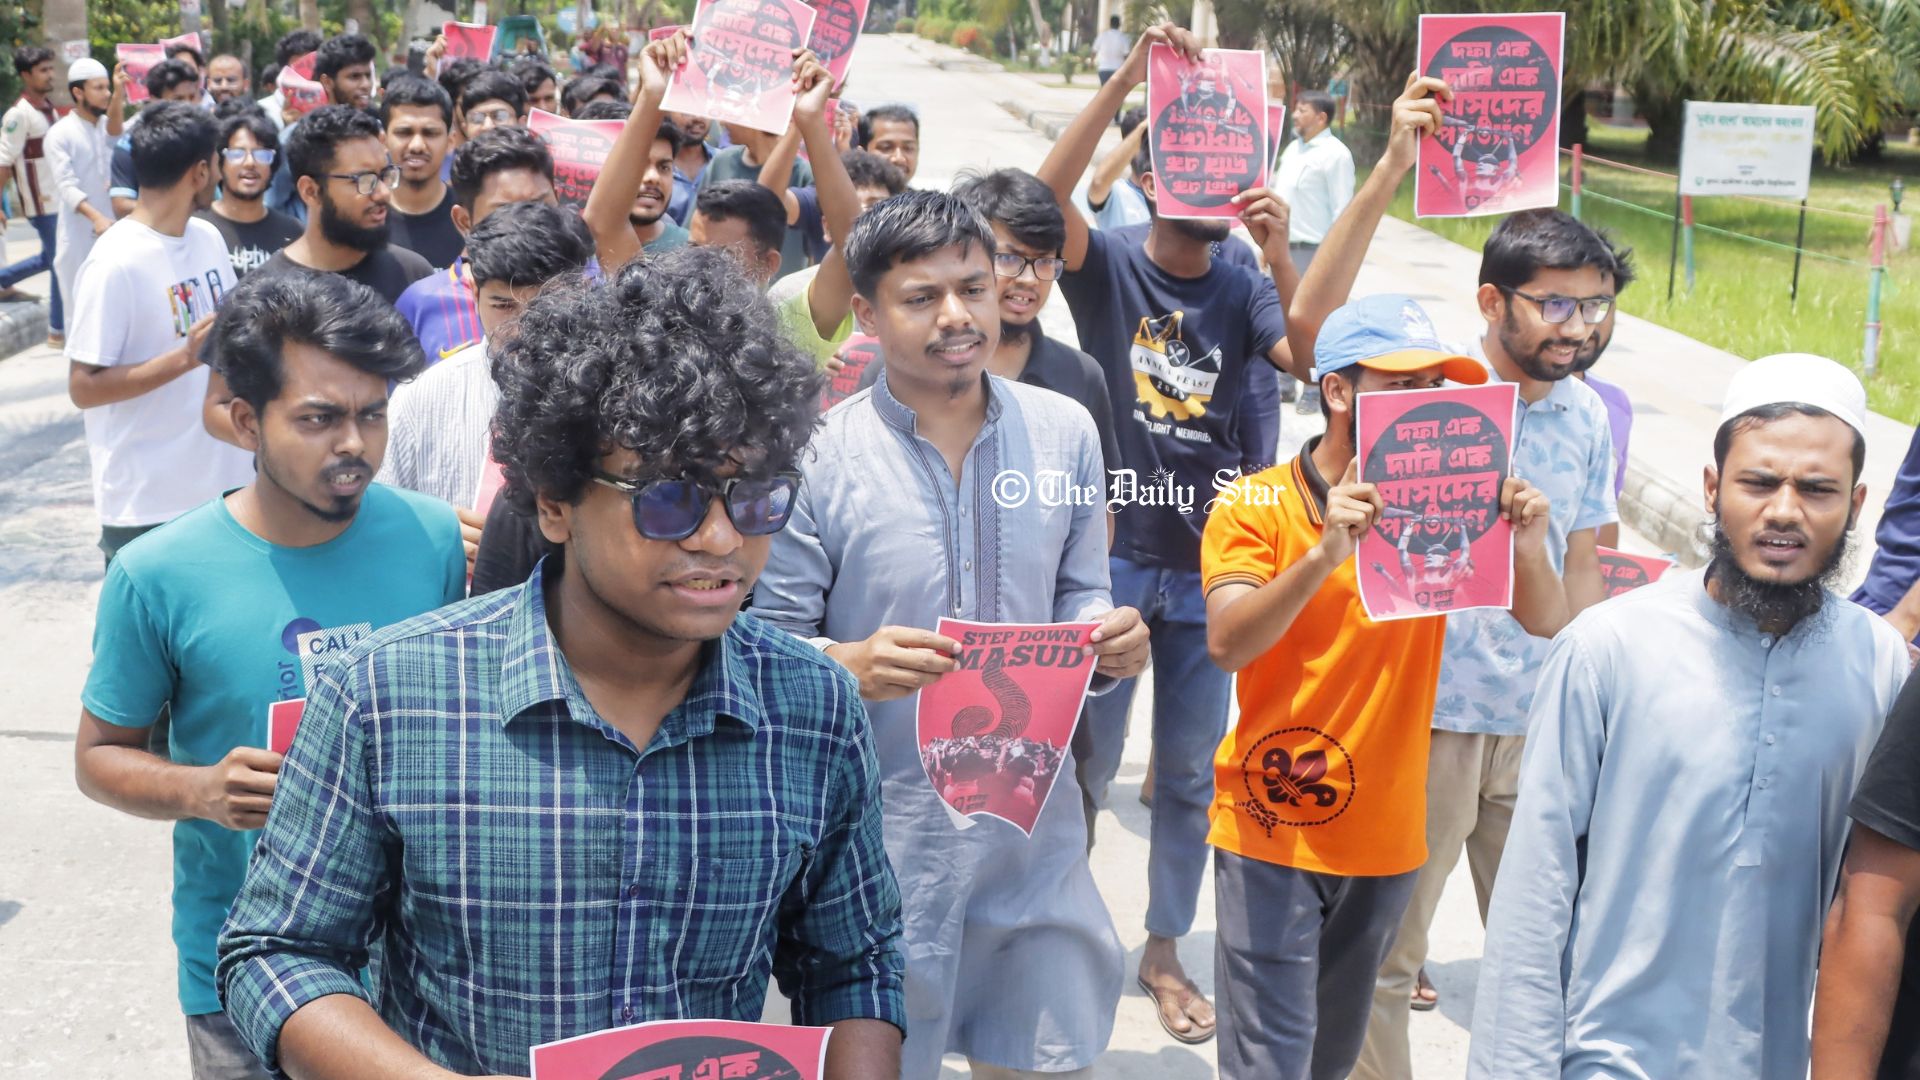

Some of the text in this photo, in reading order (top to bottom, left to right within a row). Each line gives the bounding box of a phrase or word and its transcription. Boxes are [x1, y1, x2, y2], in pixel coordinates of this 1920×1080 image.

[1451, 41, 1531, 59] দফা এক
[1441, 61, 1541, 89] দাবি এক
[1137, 355, 1209, 388] ANNUA FEAST
[1395, 416, 1482, 443] দফা এক
[1384, 443, 1493, 475] দাবি এক
[962, 629, 1081, 646] STEP DOWN
[955, 644, 1085, 670] MASUD
